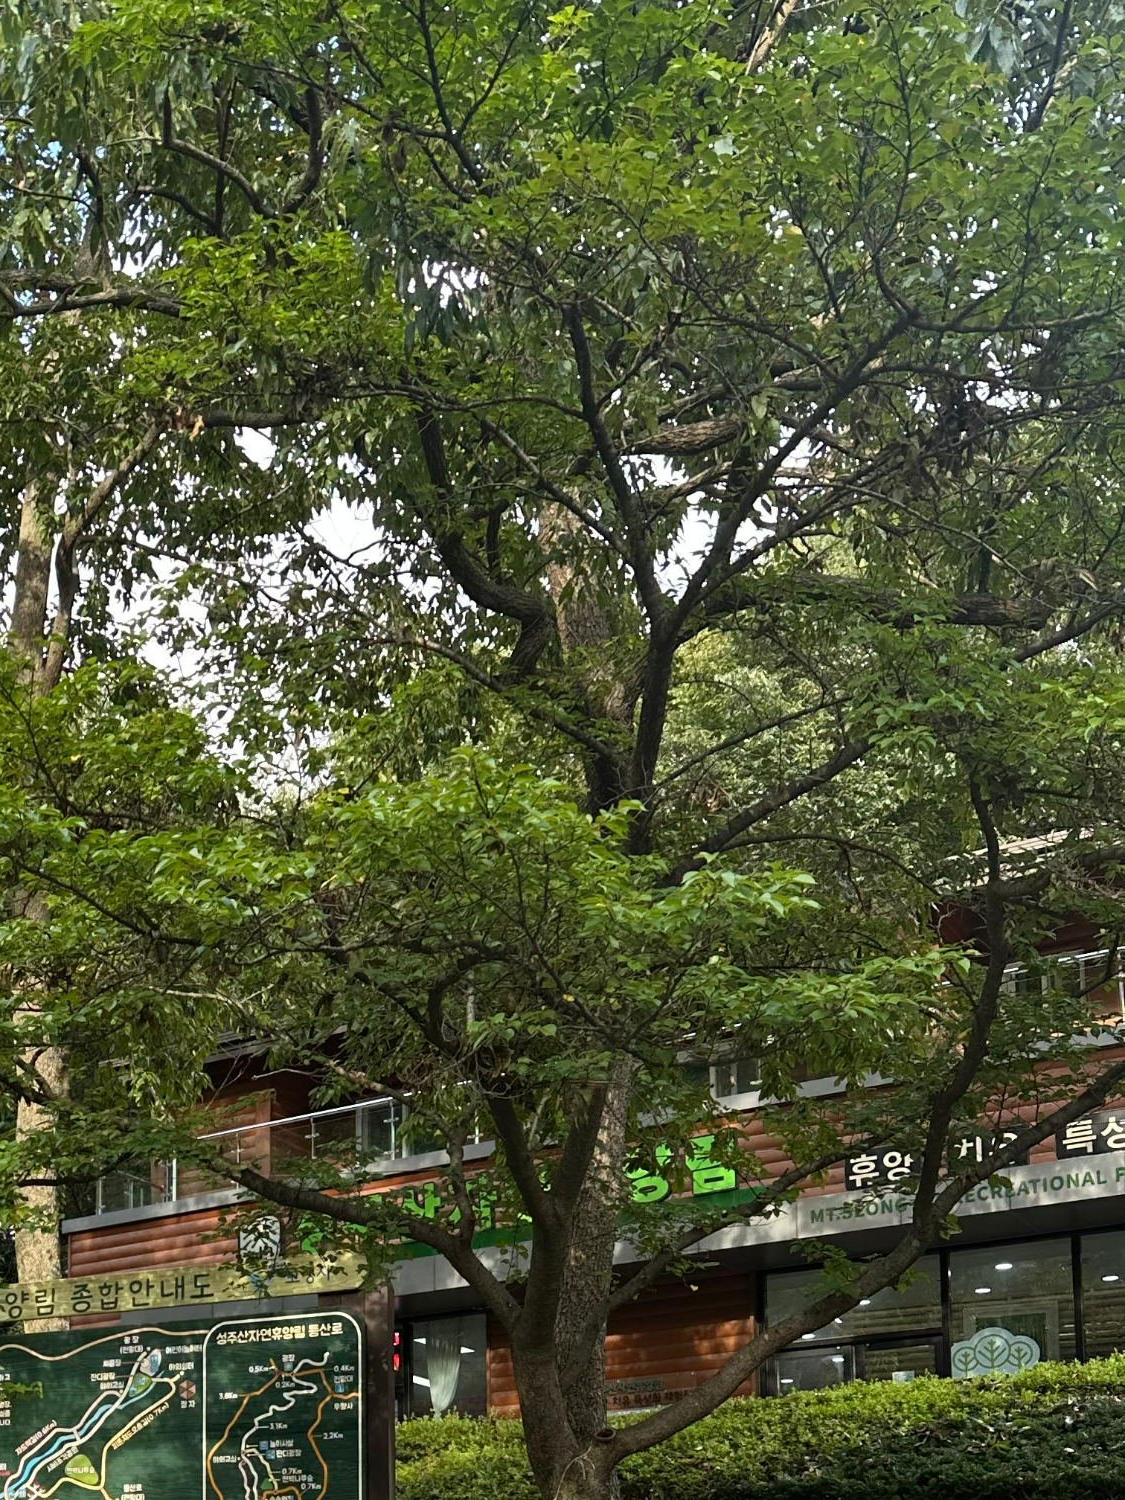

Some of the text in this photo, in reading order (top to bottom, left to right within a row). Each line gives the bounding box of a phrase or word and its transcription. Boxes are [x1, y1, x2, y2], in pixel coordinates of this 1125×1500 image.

[848, 1150, 914, 1188] 휴양
[810, 1170, 1107, 1224] MT.SEONG ECREATIONAL
[71, 1274, 214, 1313] 종합안내도
[216, 1322, 343, 1345] 성주산자연휴양림 등산로
[165, 1344, 202, 1354] 어린이놀이터
[323, 1432, 343, 1440] 2.2Km
[276, 1449, 301, 1458] 잔디광장
[282, 1475, 313, 1483] 편백나무숲
